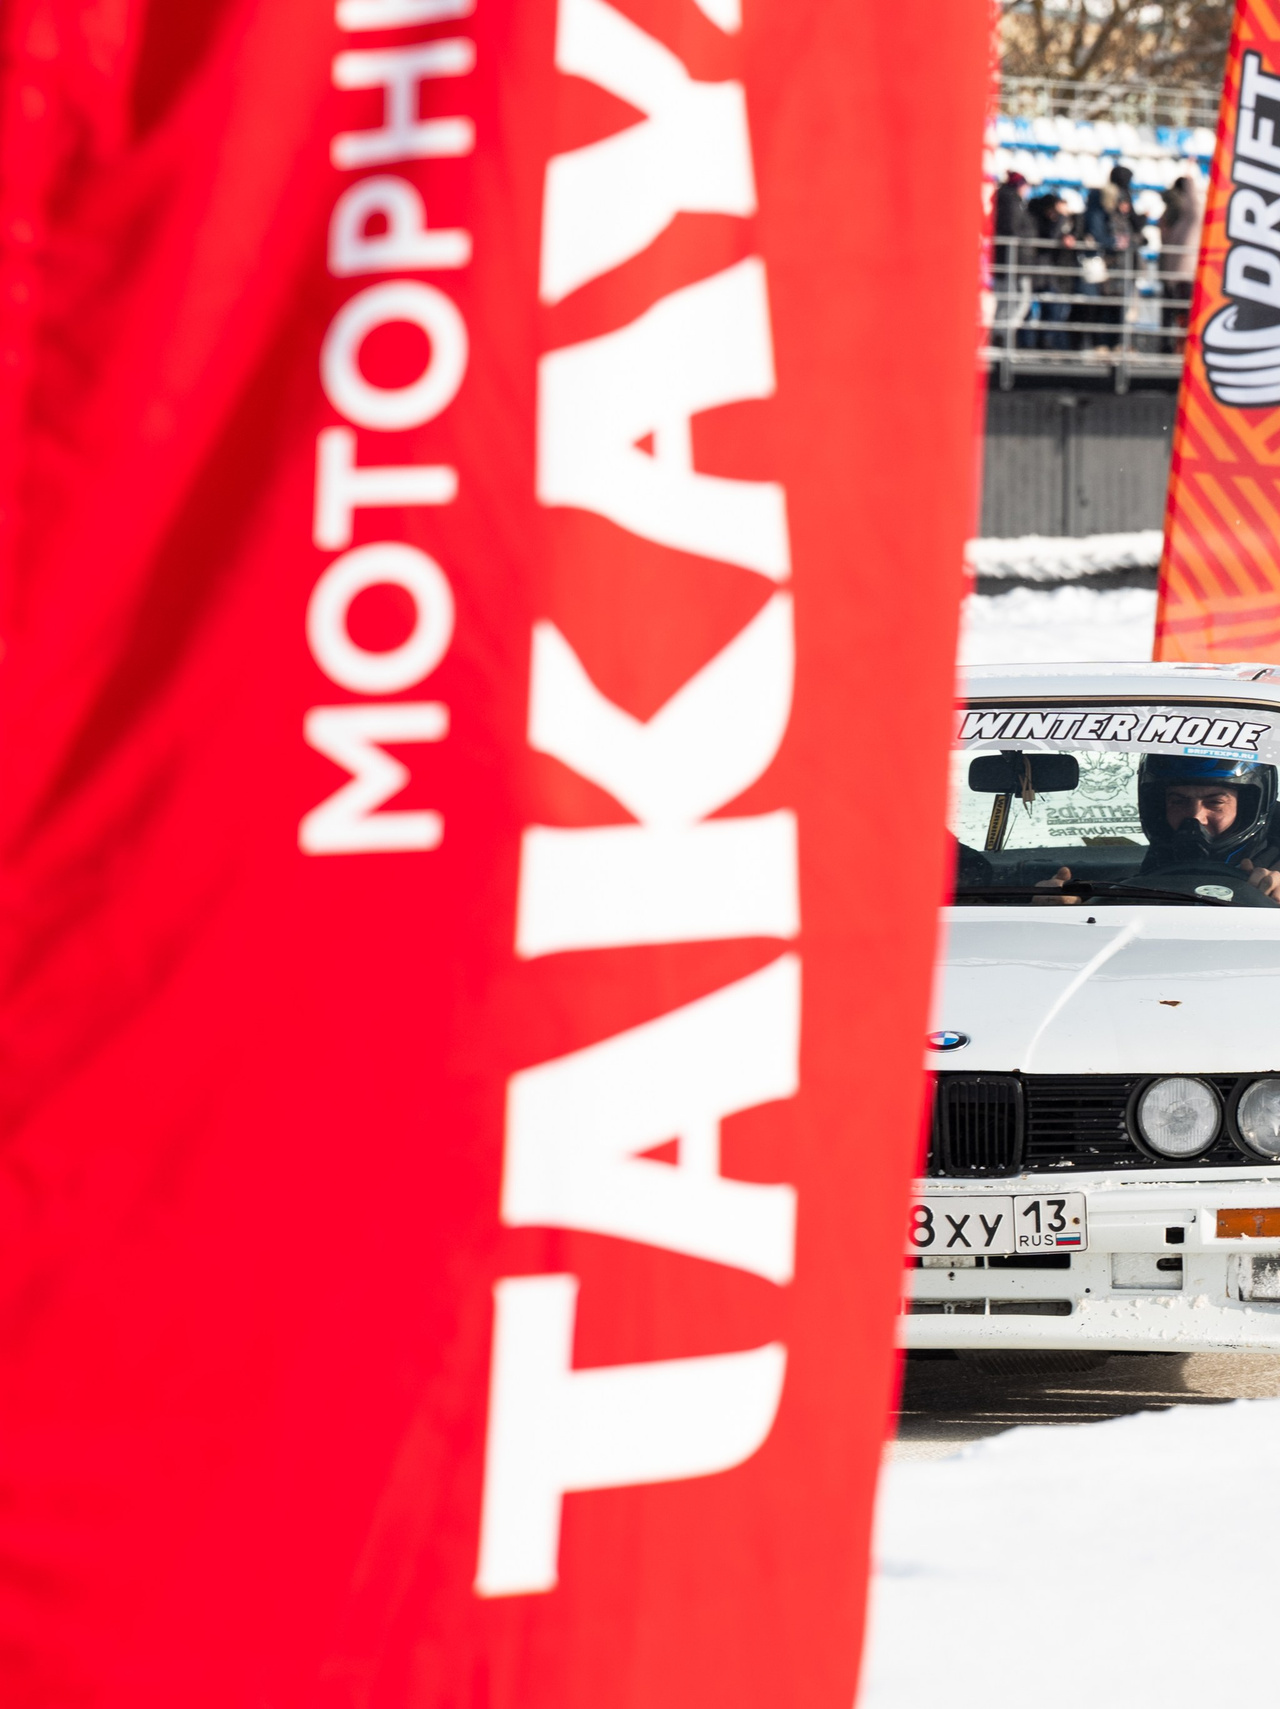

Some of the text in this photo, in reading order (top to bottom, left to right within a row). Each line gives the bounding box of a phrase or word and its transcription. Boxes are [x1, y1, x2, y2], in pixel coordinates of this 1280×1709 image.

[958, 712, 1272, 751] WINTER MODE
[1187, 748, 1255, 759] DRIFTEXPO.RU
[475, 0, 801, 1598] TAKAY
[908, 1199, 1067, 1248] 8ХУ 13
[1019, 1235, 1054, 1247] RUS
